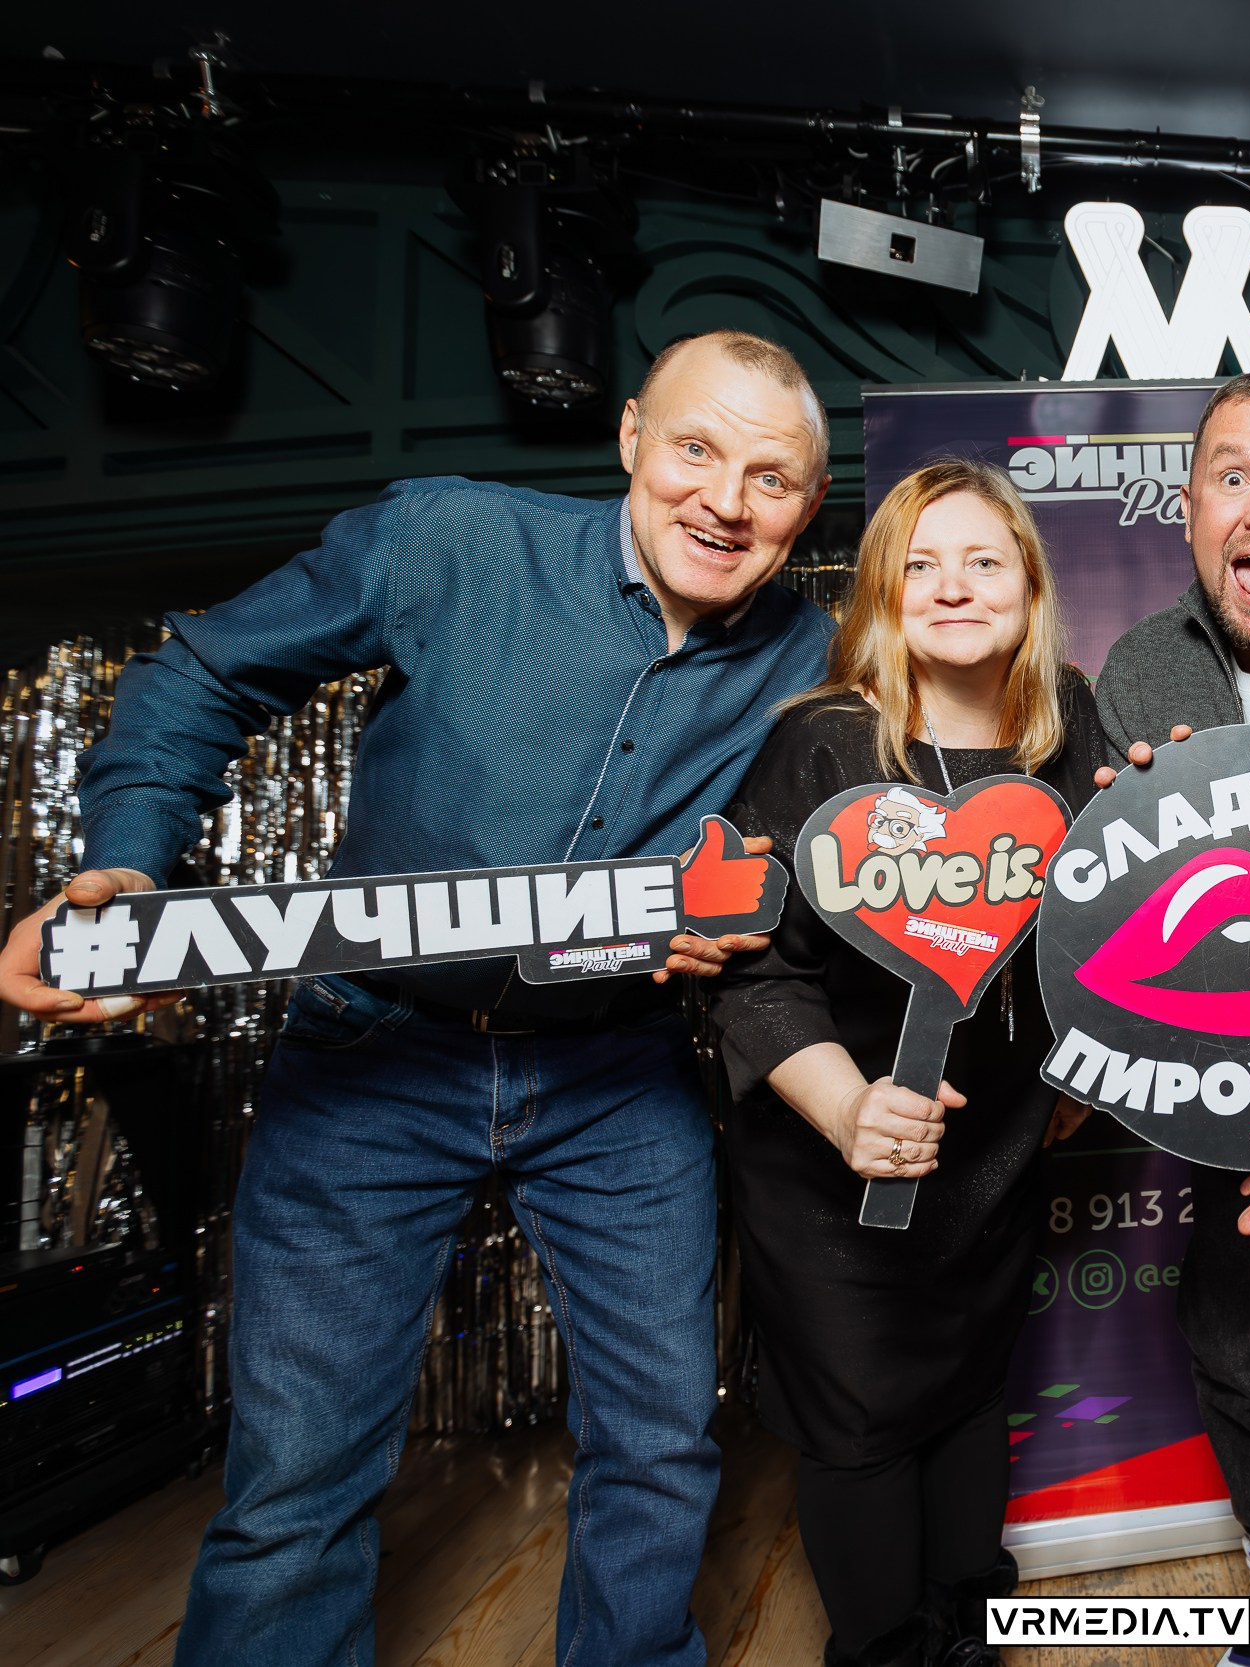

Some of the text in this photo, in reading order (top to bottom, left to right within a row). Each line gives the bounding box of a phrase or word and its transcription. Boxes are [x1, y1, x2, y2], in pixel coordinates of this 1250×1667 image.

[809, 834, 982, 913] Love
[50, 865, 678, 990] #ЛУЧШИЕ
[929, 935, 971, 957] Party
[580, 957, 623, 974] Party
[1049, 1196, 1074, 1234] 8
[1088, 1189, 1164, 1231] 913
